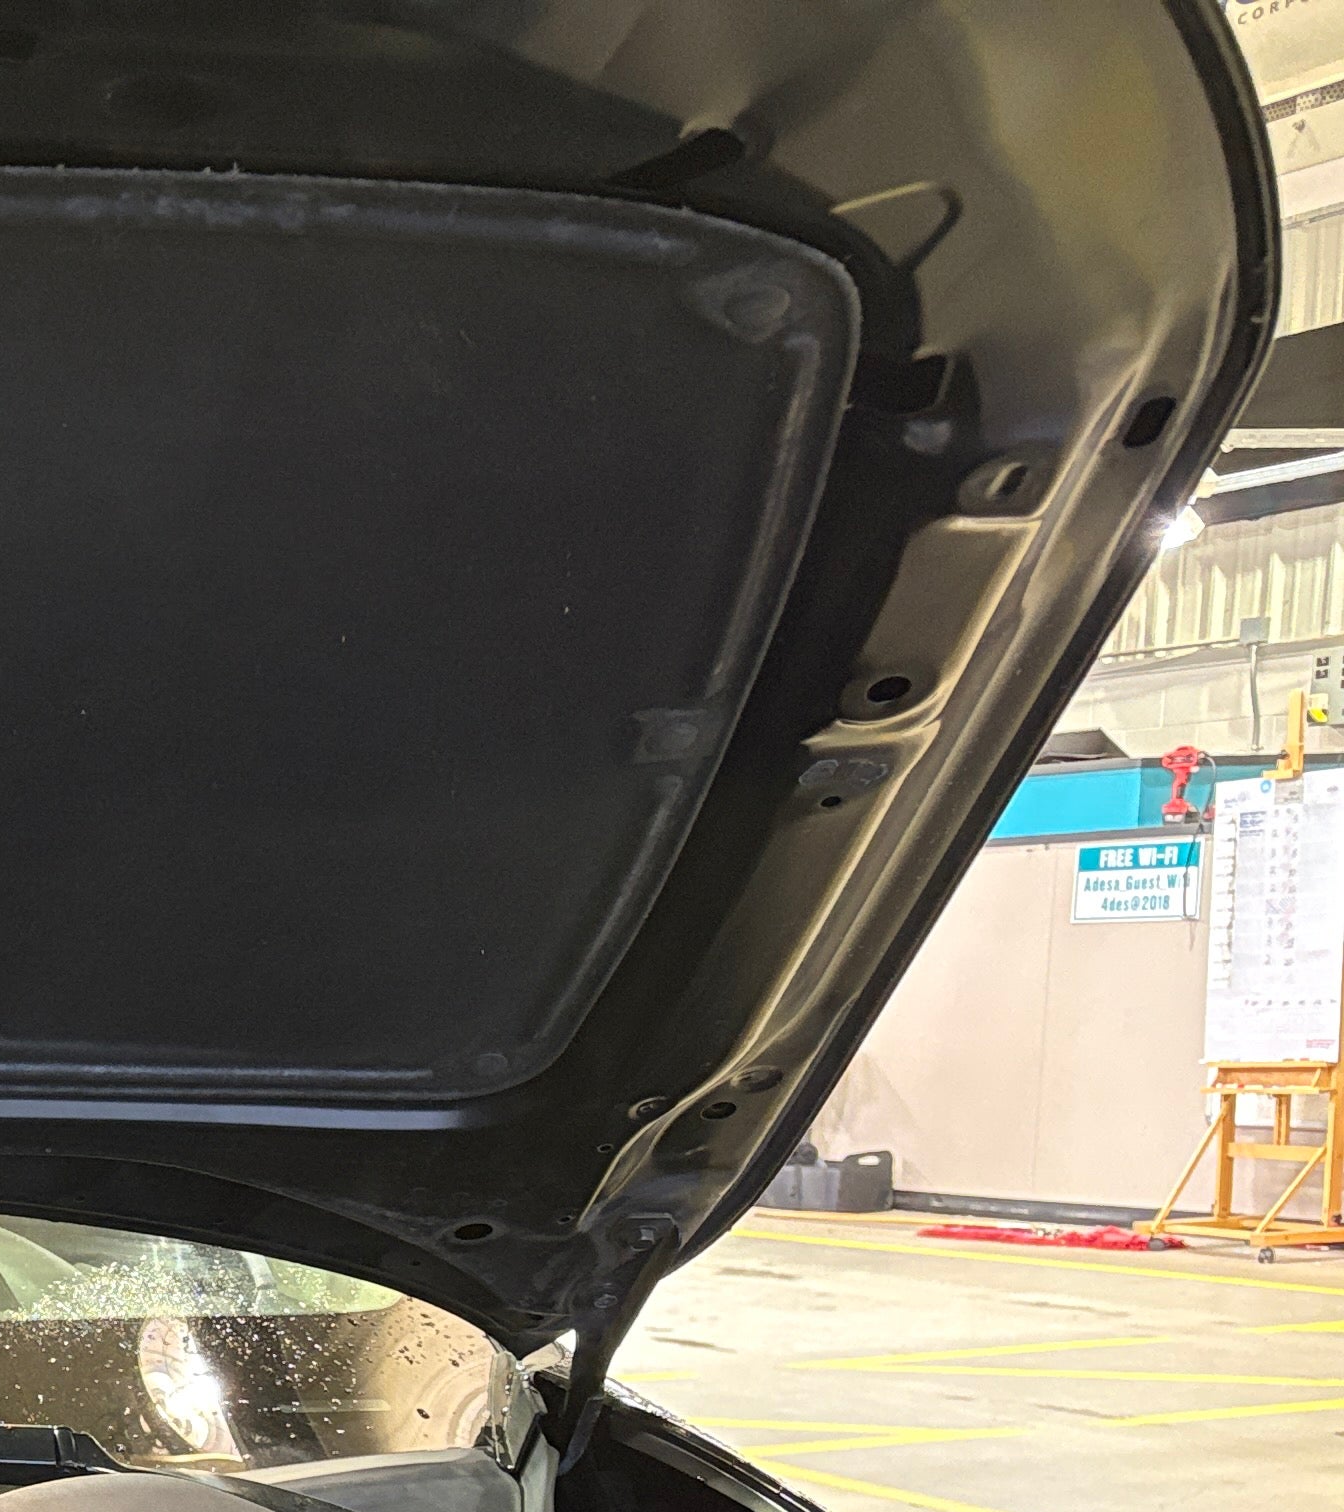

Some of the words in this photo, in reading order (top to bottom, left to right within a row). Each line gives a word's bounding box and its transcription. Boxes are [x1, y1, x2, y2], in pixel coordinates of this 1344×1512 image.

[1237, 0, 1309, 25] CORP
[1099, 848, 1133, 868] FREE
[1138, 846, 1178, 866] WI-FI
[1101, 895, 1170, 912] 4des@2018
